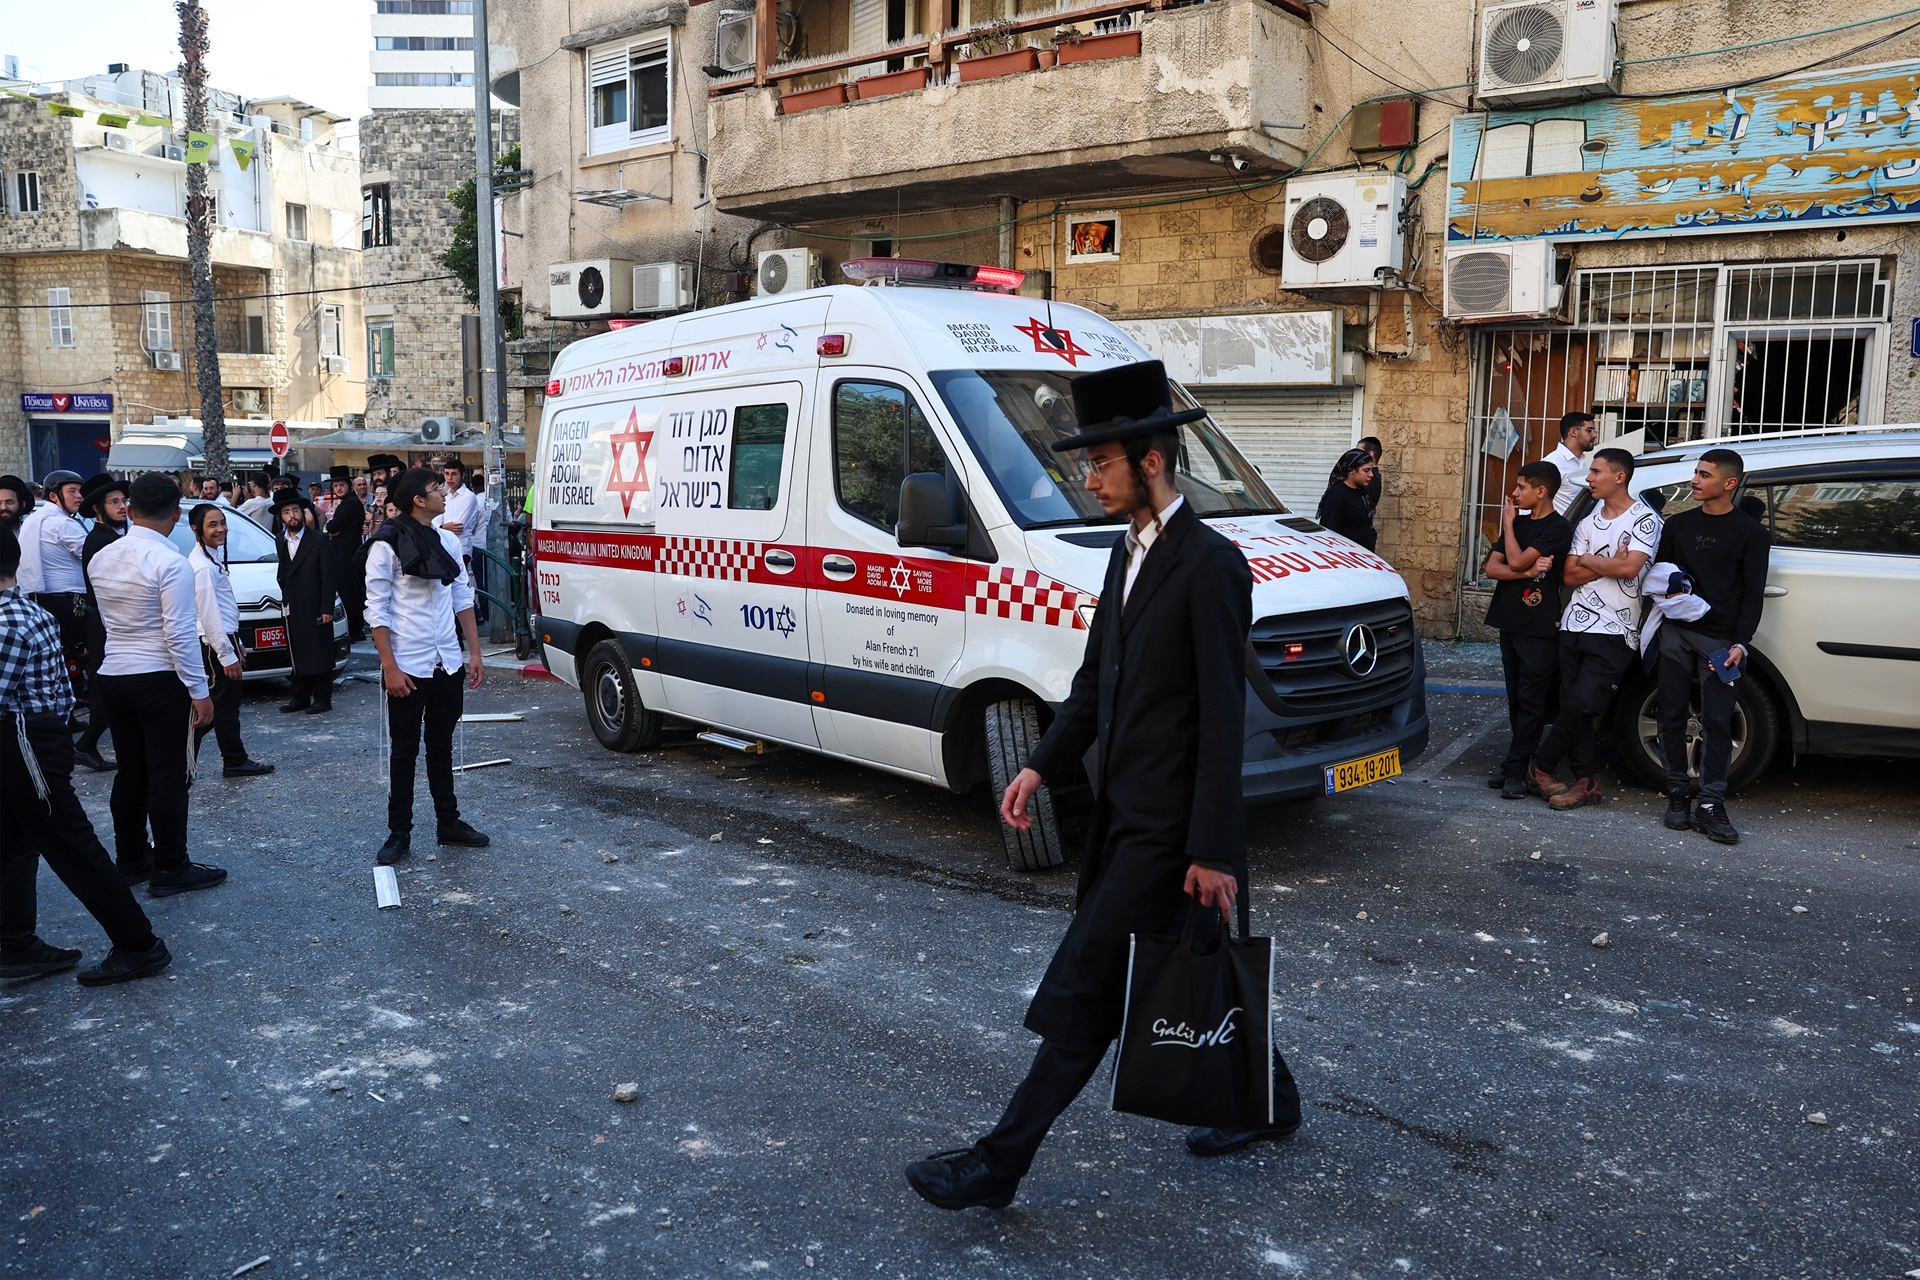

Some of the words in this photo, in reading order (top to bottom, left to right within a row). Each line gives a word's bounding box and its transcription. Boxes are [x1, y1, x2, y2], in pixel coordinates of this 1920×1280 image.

[1080, 331, 1102, 341] דוד
[1102, 335, 1121, 344] מגן
[964, 345, 980, 353] IN
[1102, 343, 1132, 354] אדום
[687, 350, 731, 377] ארגון
[569, 368, 613, 392] הלאומי
[553, 421, 589, 441] MAGEN
[669, 411, 695, 438] דוד
[699, 408, 727, 442] מגן
[552, 443, 582, 462] DAVID
[683, 445, 725, 472] אדום
[551, 465, 581, 483] ADOM
[549, 486, 560, 504] IN
[562, 486, 595, 505] ISRAEL
[660, 476, 721, 508] בישראל
[538, 539, 557, 552] MAGEN
[557, 541, 572, 554] DAVID
[573, 542, 590, 556] ADOM
[590, 543, 597, 556] IN
[598, 544, 620, 558] UNITED
[621, 545, 652, 560] KINGDOM
[1250, 536, 1308, 547] דוד
[1304, 536, 1357, 548] מגן
[867, 565, 885, 573] MAGEN
[913, 570, 933, 578] SAVING
[1248, 551, 1398, 584] MBULANCE
[540, 570, 560, 586] כרמל
[543, 591, 560, 603] 1754
[918, 585, 932, 593] LIVES
[740, 604, 775, 631] 101
[846, 603, 874, 616] Donated
[875, 606, 883, 617] in
[884, 607, 906, 622] loving
[907, 612, 938, 626] memory
[886, 625, 895, 636] of
[865, 640, 881, 652] Alan
[883, 642, 907, 656] French
[852, 655, 861, 668] by
[862, 656, 873, 668] his
[874, 659, 889, 670] wife
[890, 663, 904, 673] and
[905, 664, 935, 678] children
[1152, 1018, 1195, 1043] Galit
